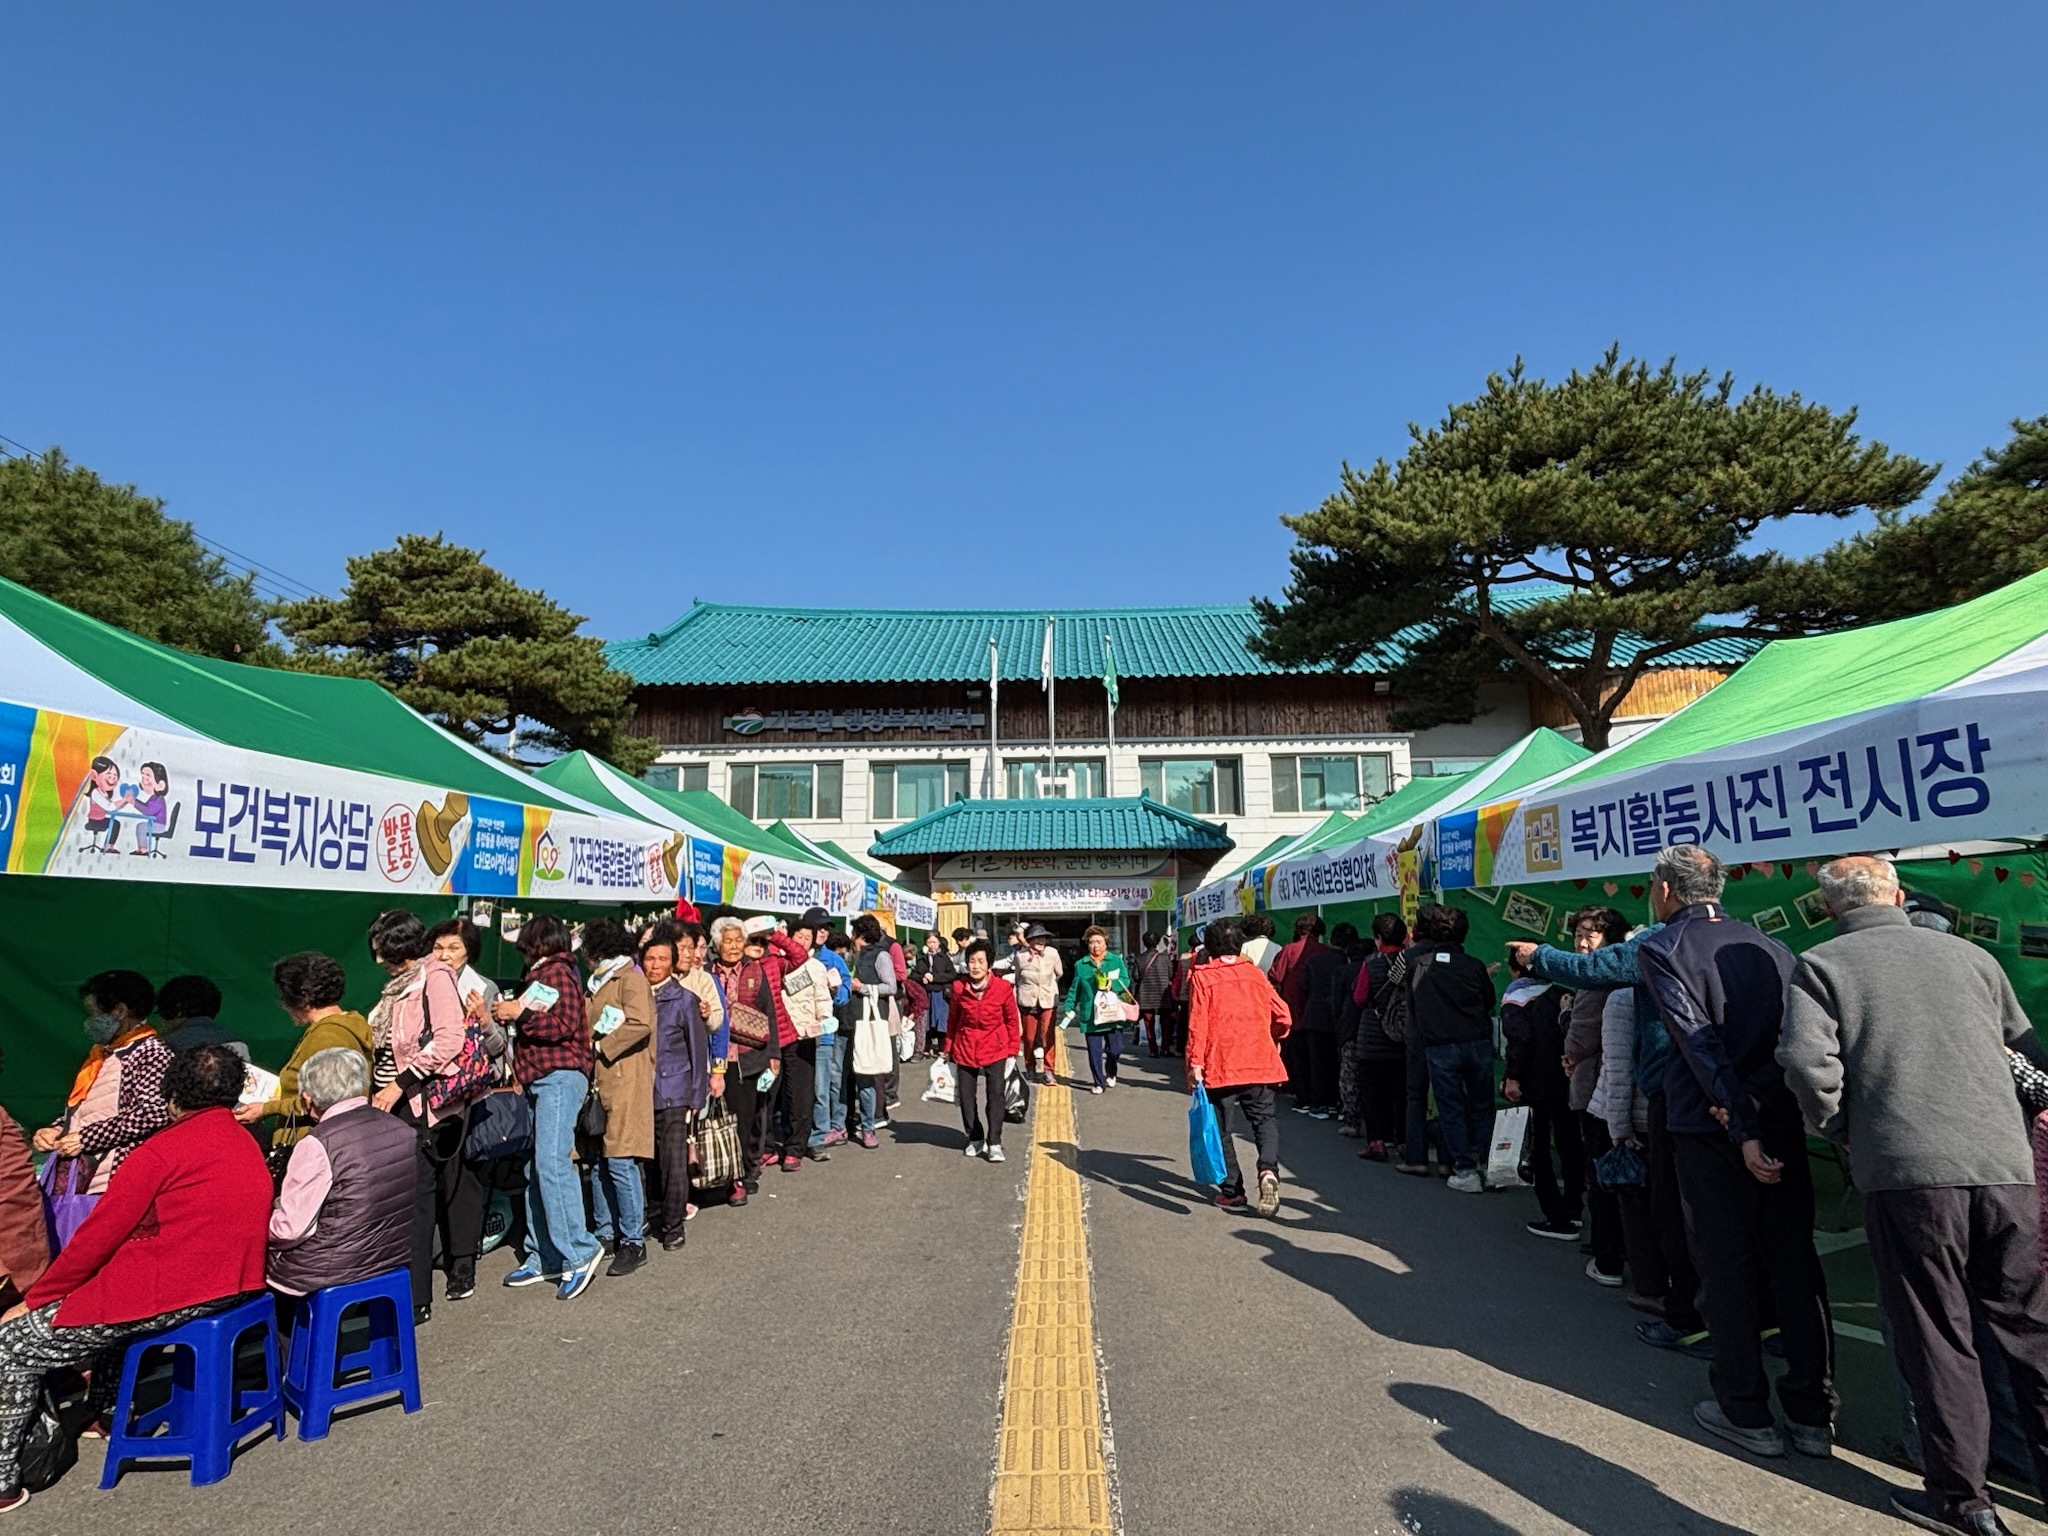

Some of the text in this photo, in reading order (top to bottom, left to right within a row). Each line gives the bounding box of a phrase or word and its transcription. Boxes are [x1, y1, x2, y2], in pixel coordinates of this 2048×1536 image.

[770, 707, 972, 733] 가조면 행정복지센터
[1570, 721, 1992, 862] 복지활동사진 전시장
[189, 779, 373, 871] 보건복지상담
[568, 836, 646, 888] 가조권역통합돌봄센터
[960, 855, 975, 873] 더
[1064, 855, 1092, 870] 군민
[1095, 855, 1149, 870] 행복시대
[1291, 852, 1378, 896] 지역사회보장협의체
[778, 873, 819, 907] 공유냉장고
[953, 890, 982, 901] 2025년
